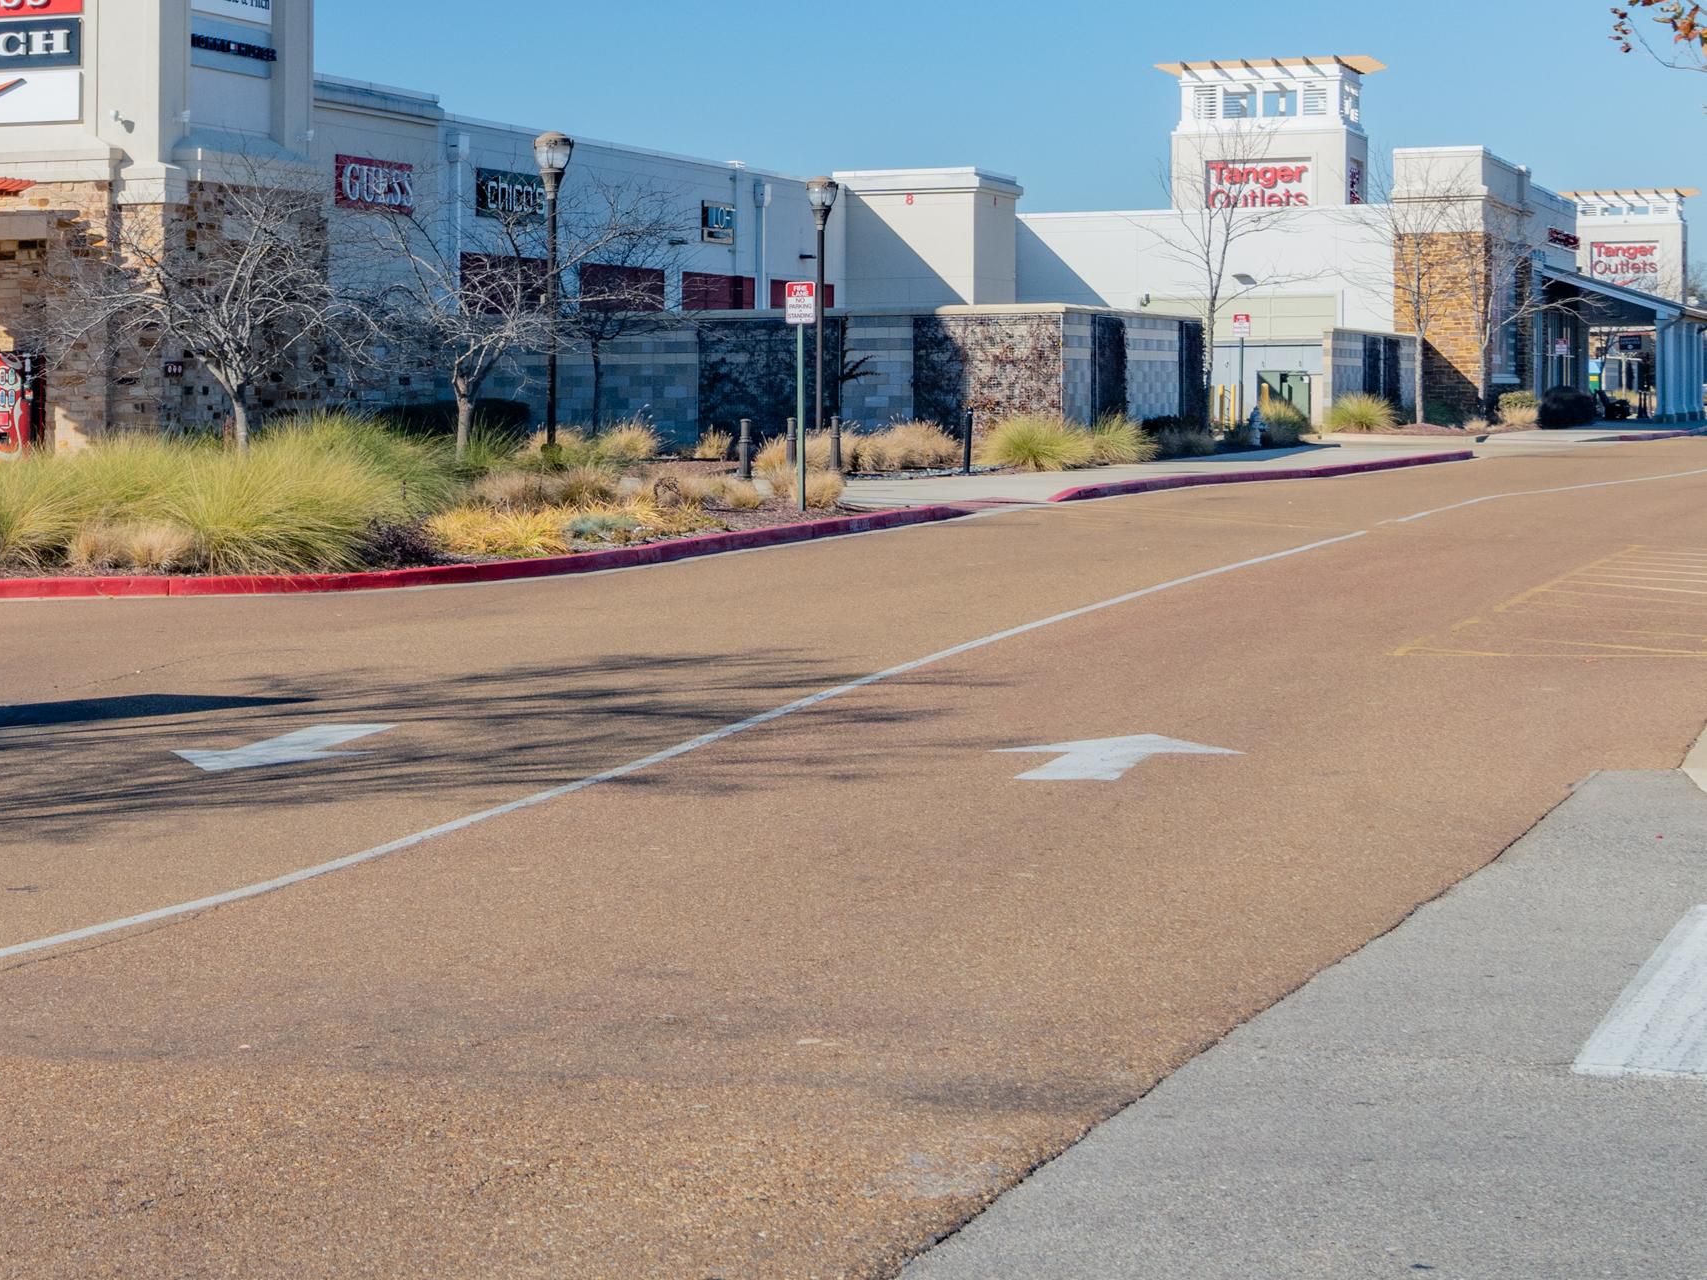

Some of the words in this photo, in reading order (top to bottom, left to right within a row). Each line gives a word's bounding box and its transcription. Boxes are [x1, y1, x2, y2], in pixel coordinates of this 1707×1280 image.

[346, 163, 414, 207] GUESS
[1208, 160, 1309, 189] Tanger
[487, 175, 545, 215] chico's
[905, 192, 914, 206] 8
[1593, 242, 1657, 260] Tanger
[1594, 260, 1658, 275] Outlets
